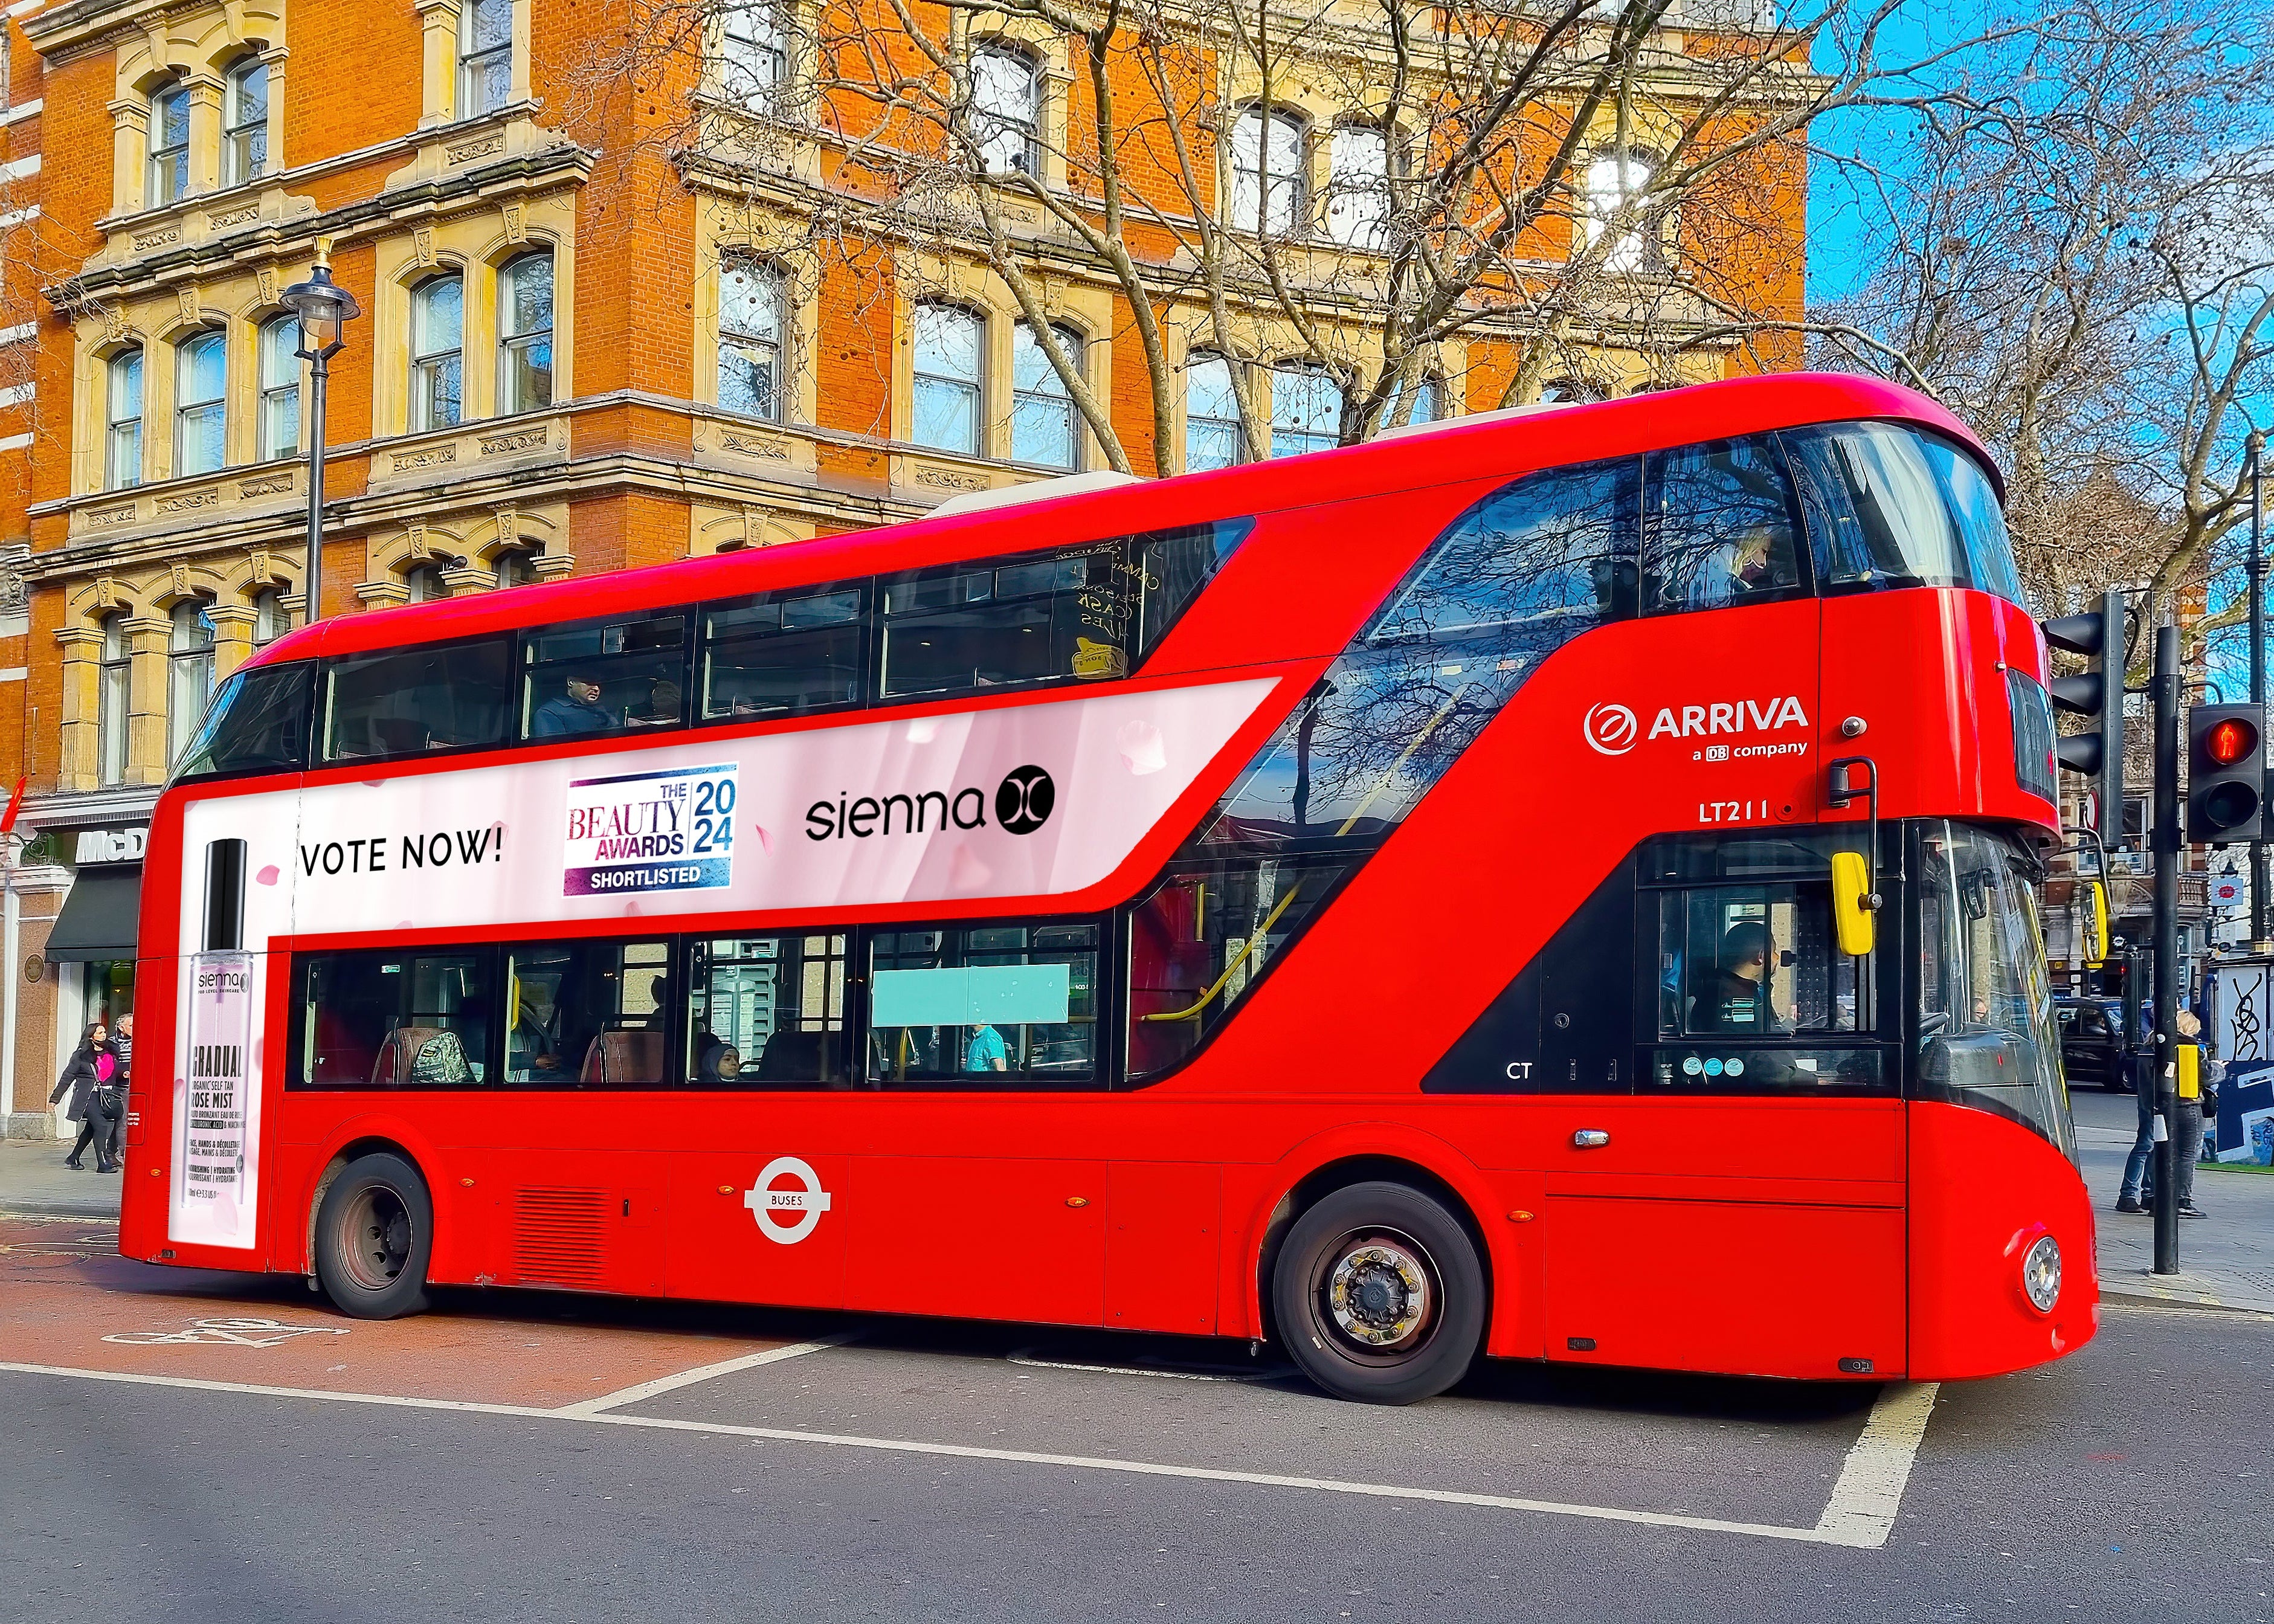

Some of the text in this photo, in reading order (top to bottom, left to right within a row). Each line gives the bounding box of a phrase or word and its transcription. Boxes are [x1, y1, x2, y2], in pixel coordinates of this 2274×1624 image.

[1648, 696, 1809, 740] ARRIVA
[1692, 743, 1808, 761] a DB company
[660, 783, 687, 799] THE
[694, 779, 736, 816] 20
[567, 799, 686, 840] BEAUTY
[805, 787, 987, 841] sienna
[1699, 799, 1767, 823] LT211
[693, 816, 733, 854] 24
[301, 827, 503, 877] VOTE NOW!
[594, 833, 684, 861] AWARDS
[590, 866, 701, 889] SHORTLISTED
[198, 971, 239, 987] sienna
[193, 1045, 242, 1077] GRADUAL
[1506, 1062, 1533, 1079] CT
[192, 1080, 234, 1091] RGANIC SELF TAN
[191, 1092, 233, 1109] ROSE MIST
[228, 1120, 246, 1129] NIACIN
[198, 1139, 211, 1148] HANDS
[188, 1164, 210, 1174] NOURISHING
[216, 1174, 238, 1183] HYDRATANTE
[208, 1190, 213, 1199] US
[771, 1195, 802, 1206] BUSES
